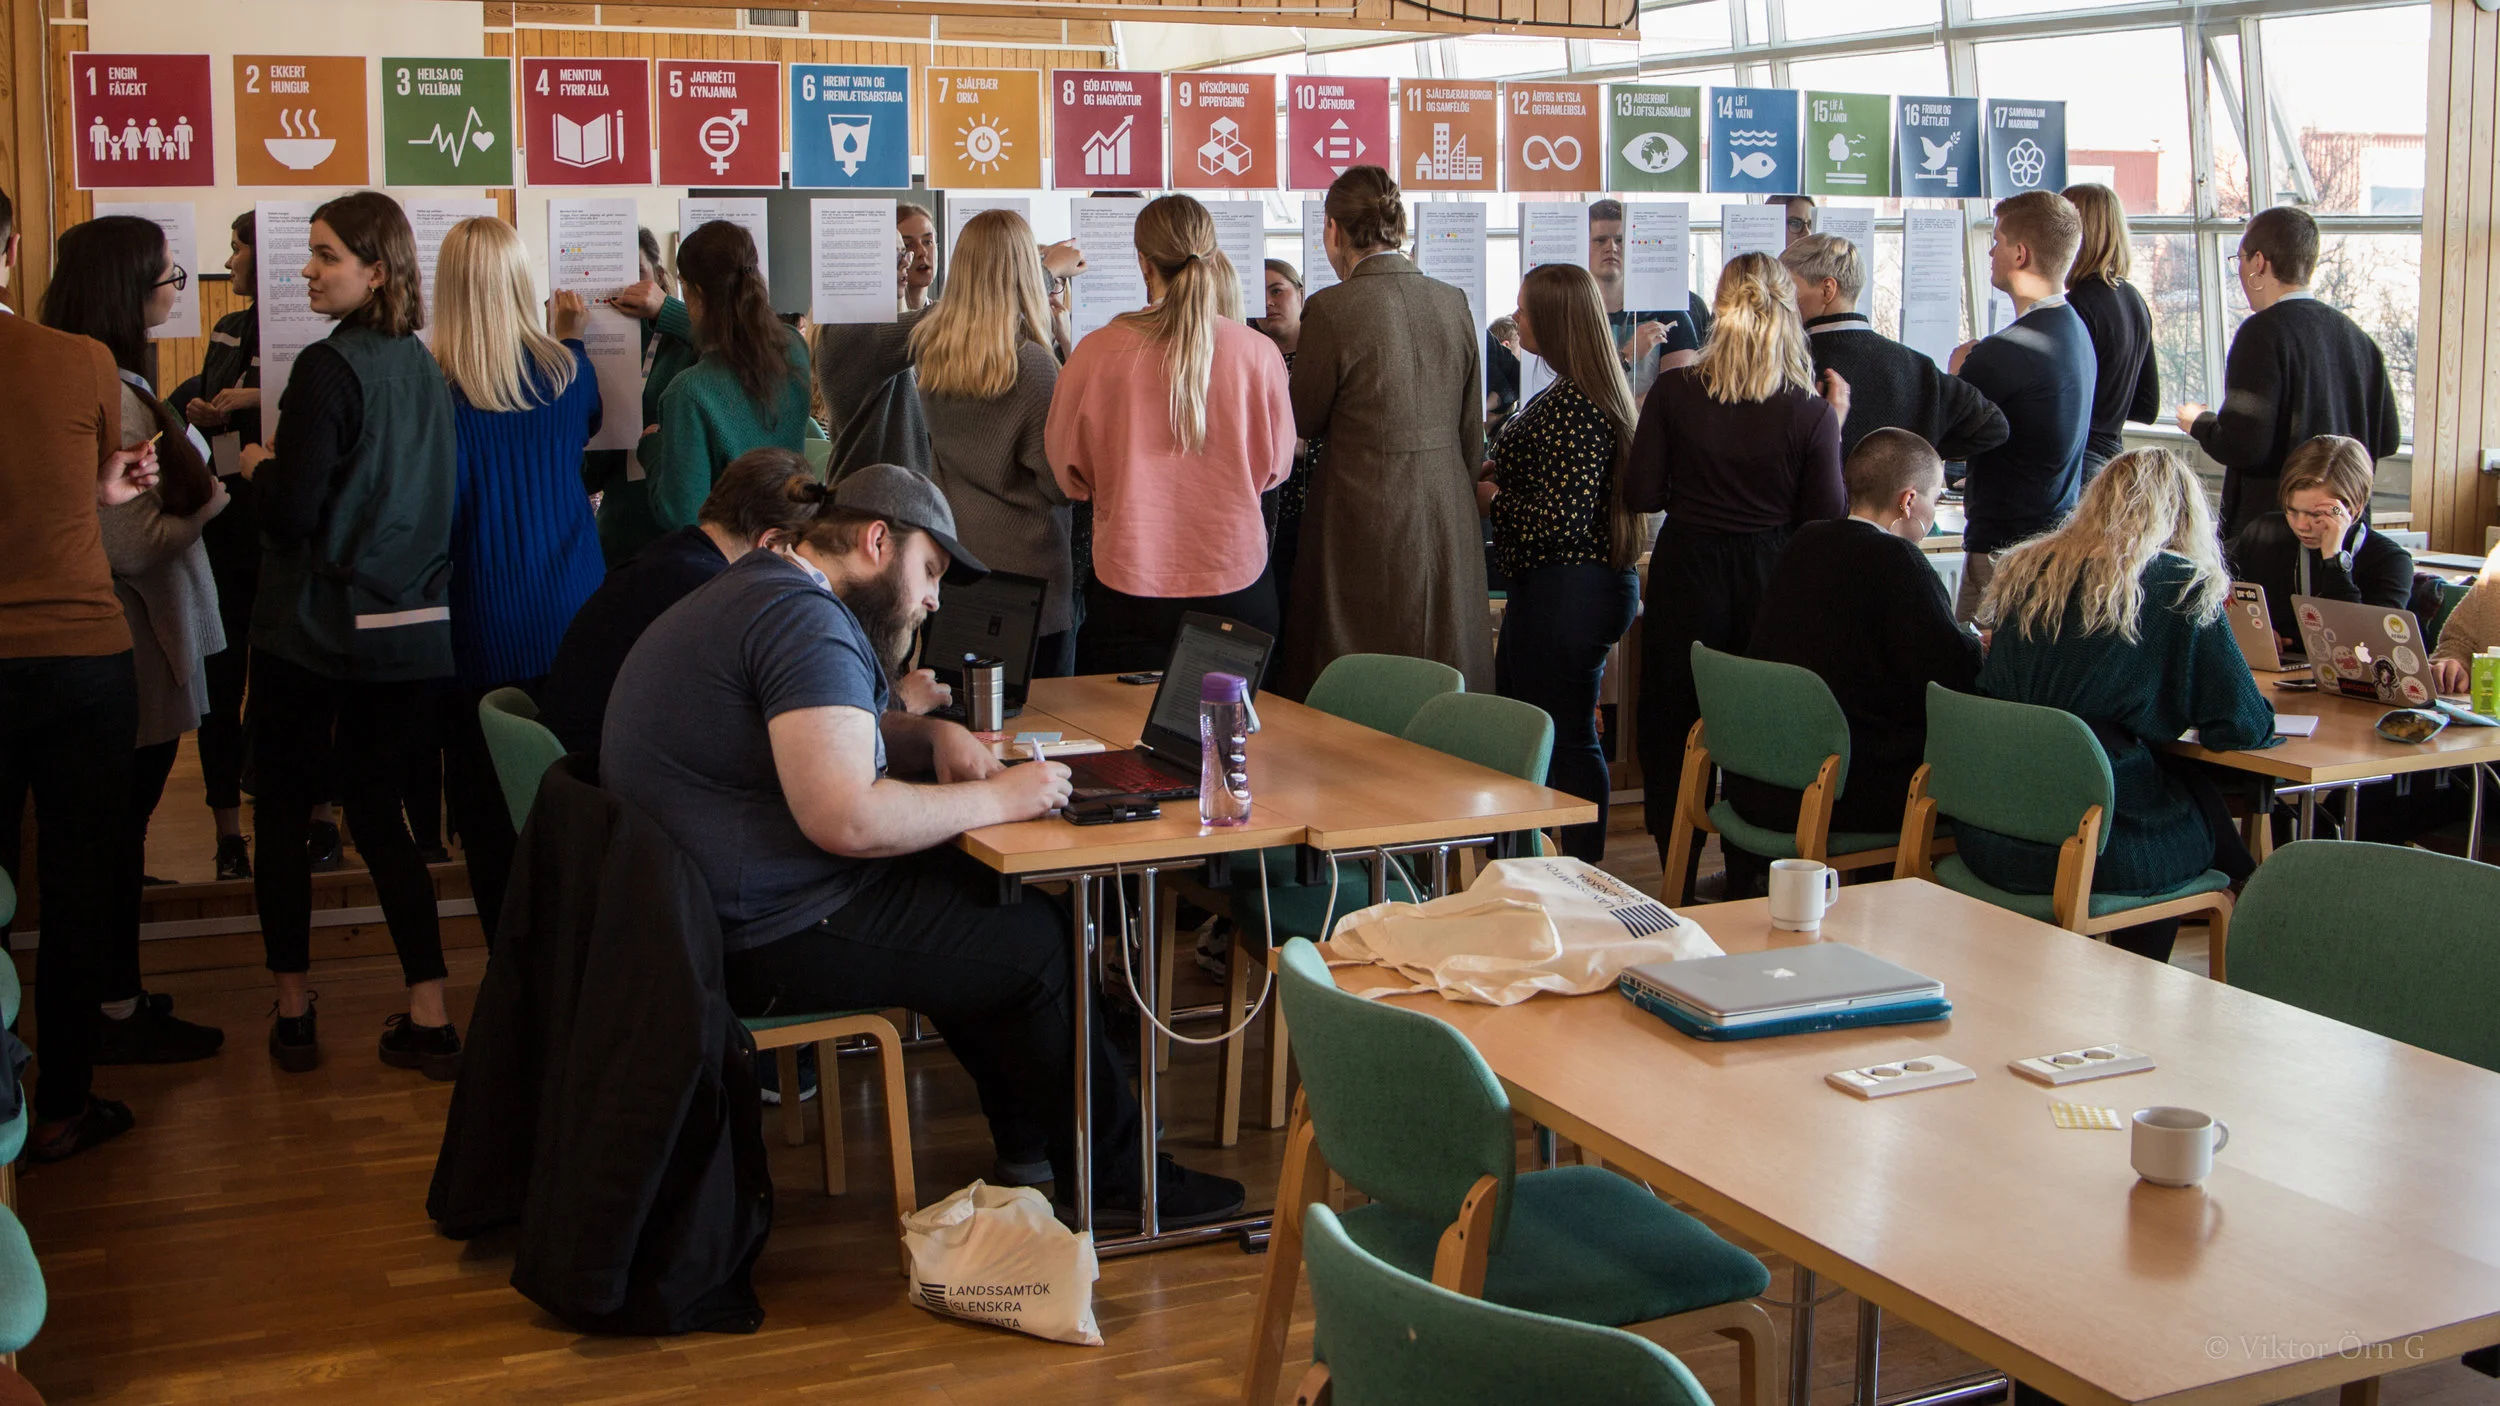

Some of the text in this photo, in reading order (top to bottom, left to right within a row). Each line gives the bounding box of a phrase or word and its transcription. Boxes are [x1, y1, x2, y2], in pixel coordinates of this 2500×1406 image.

[109, 67, 137, 80] ENGIN
[271, 66, 306, 78] EKKERT
[418, 68, 463, 80] HEILSA OG
[560, 69, 601, 81] MENNTUN
[690, 70, 735, 84] JAFNRÉTTI
[87, 67, 96, 95] 1
[246, 65, 260, 93] 2
[397, 68, 410, 95] 3
[536, 69, 549, 96] 4
[669, 71, 682, 97] 5
[823, 76, 884, 88] HREINT VATN OG
[957, 77, 998, 90] SJÁLFBÆR
[109, 81, 147, 96] FÁTÆKT
[271, 81, 309, 93] HUNGUR
[418, 82, 461, 95] VELLÍÐAN
[560, 84, 609, 96] FYRIR ALLA
[690, 86, 737, 98] KYNJANNA
[803, 74, 816, 100] 6
[938, 77, 948, 103] 7
[1063, 80, 1075, 105] 8
[1100, 80, 1132, 92] ATVINNA
[1200, 81, 1249, 94] NÝSKÖPUN OG
[1318, 85, 1344, 96] AUKINN
[957, 92, 978, 103] ORKA
[1084, 93, 1141, 106] OG HAGVÖXTUR
[1179, 82, 1192, 107] 9
[1296, 85, 1315, 109] 10
[1406, 88, 1421, 112] 11
[1470, 90, 1492, 100] BORGIR
[1556, 92, 1580, 103] NEYSLA
[1200, 96, 1244, 108] UPPBYGGING
[1426, 102, 1436, 112] OG
[1512, 91, 1529, 115] 12
[1616, 93, 1632, 116] 13
[1717, 96, 1733, 118] 14
[1532, 105, 1541, 114] OG
[1736, 109, 1752, 119] VATNI
[1812, 100, 1828, 122] 15
[1904, 104, 1920, 126] 16
[1942, 105, 1951, 115] OG
[2037, 108, 2045, 118] UM
[1830, 113, 1847, 123] LANDI
[1994, 106, 2006, 129] 17
[949, 1282, 1050, 1296] LANDSSAMTÖK
